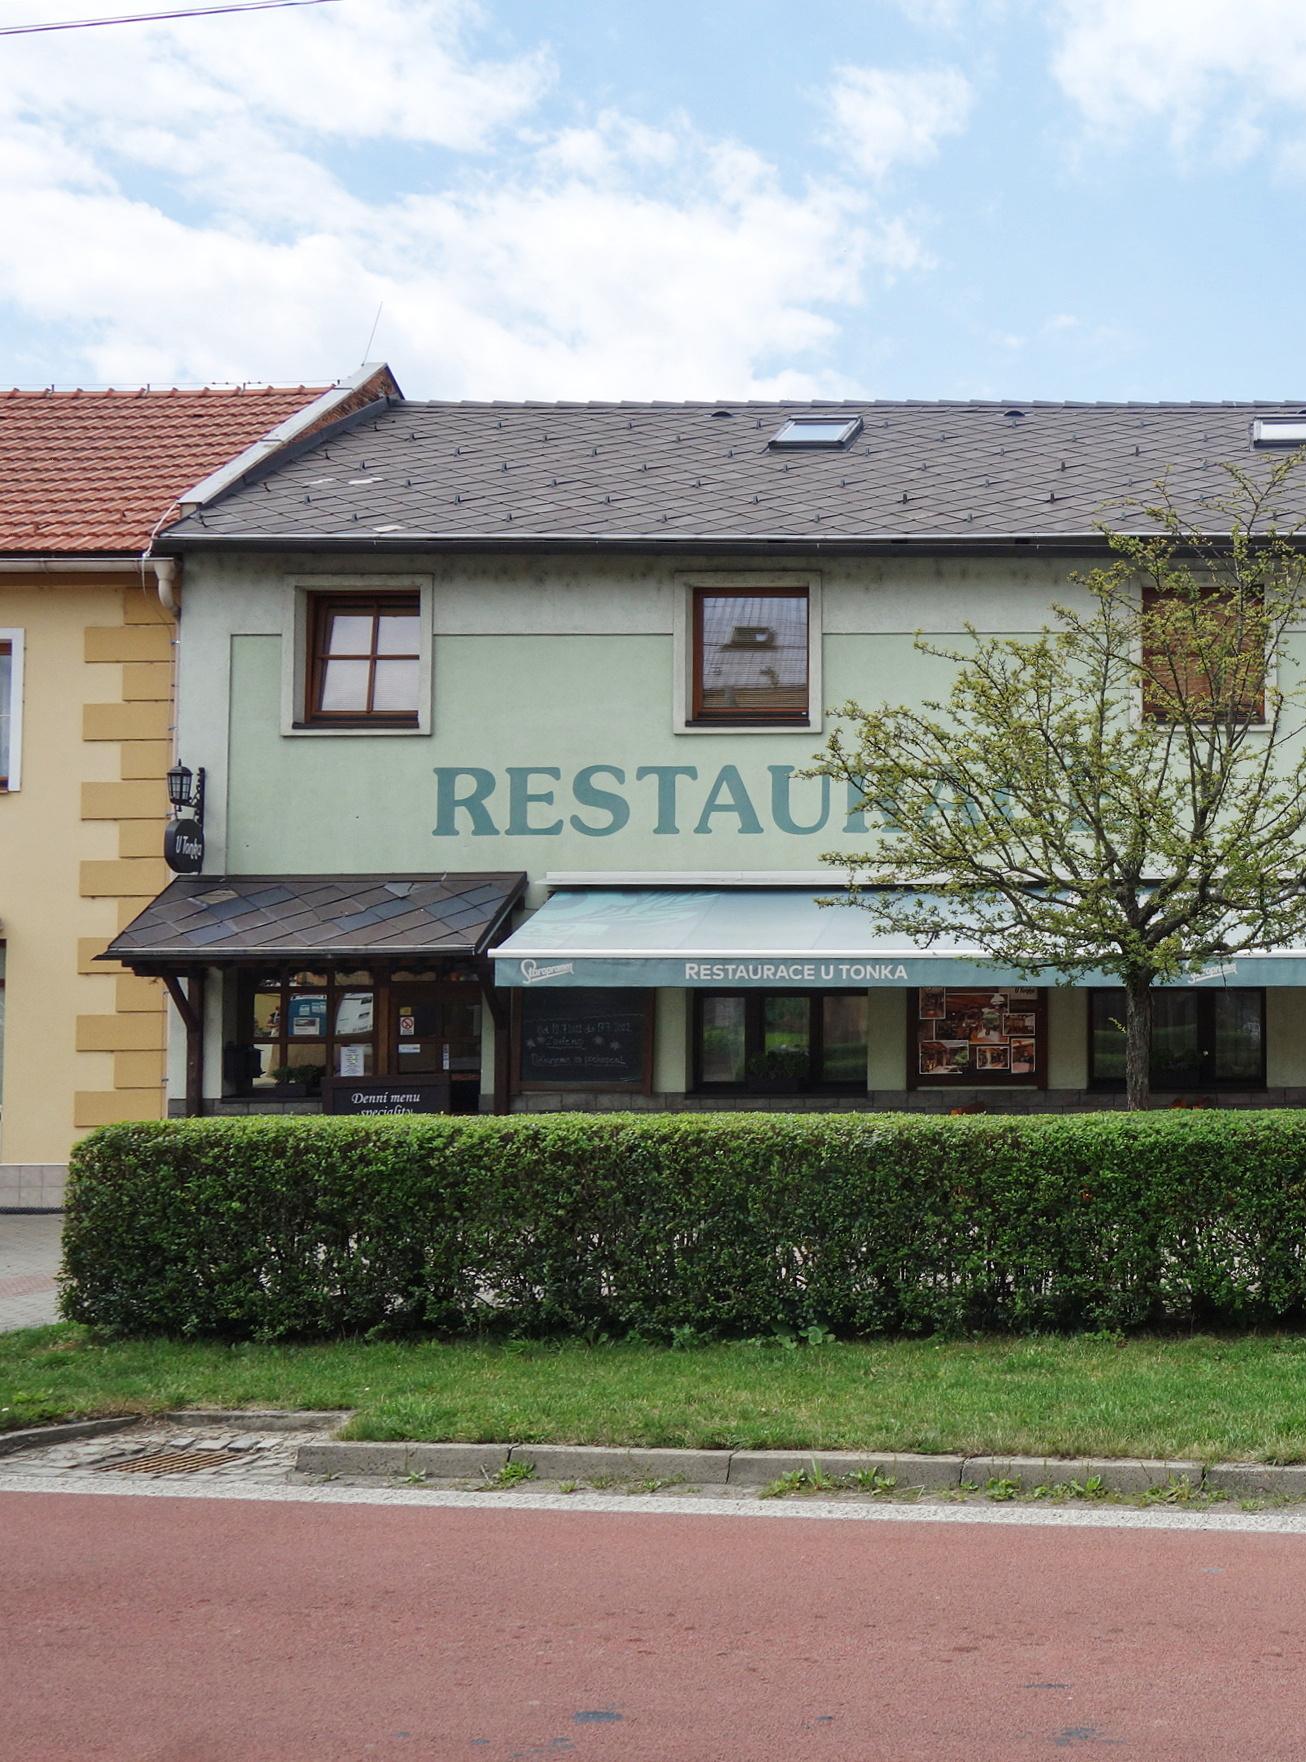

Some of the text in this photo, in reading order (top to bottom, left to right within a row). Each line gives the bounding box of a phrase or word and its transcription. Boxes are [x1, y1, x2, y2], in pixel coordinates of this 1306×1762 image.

[685, 963, 908, 980] RESTAURACE U TONKA
[351, 1092, 421, 1104] Denní menu
